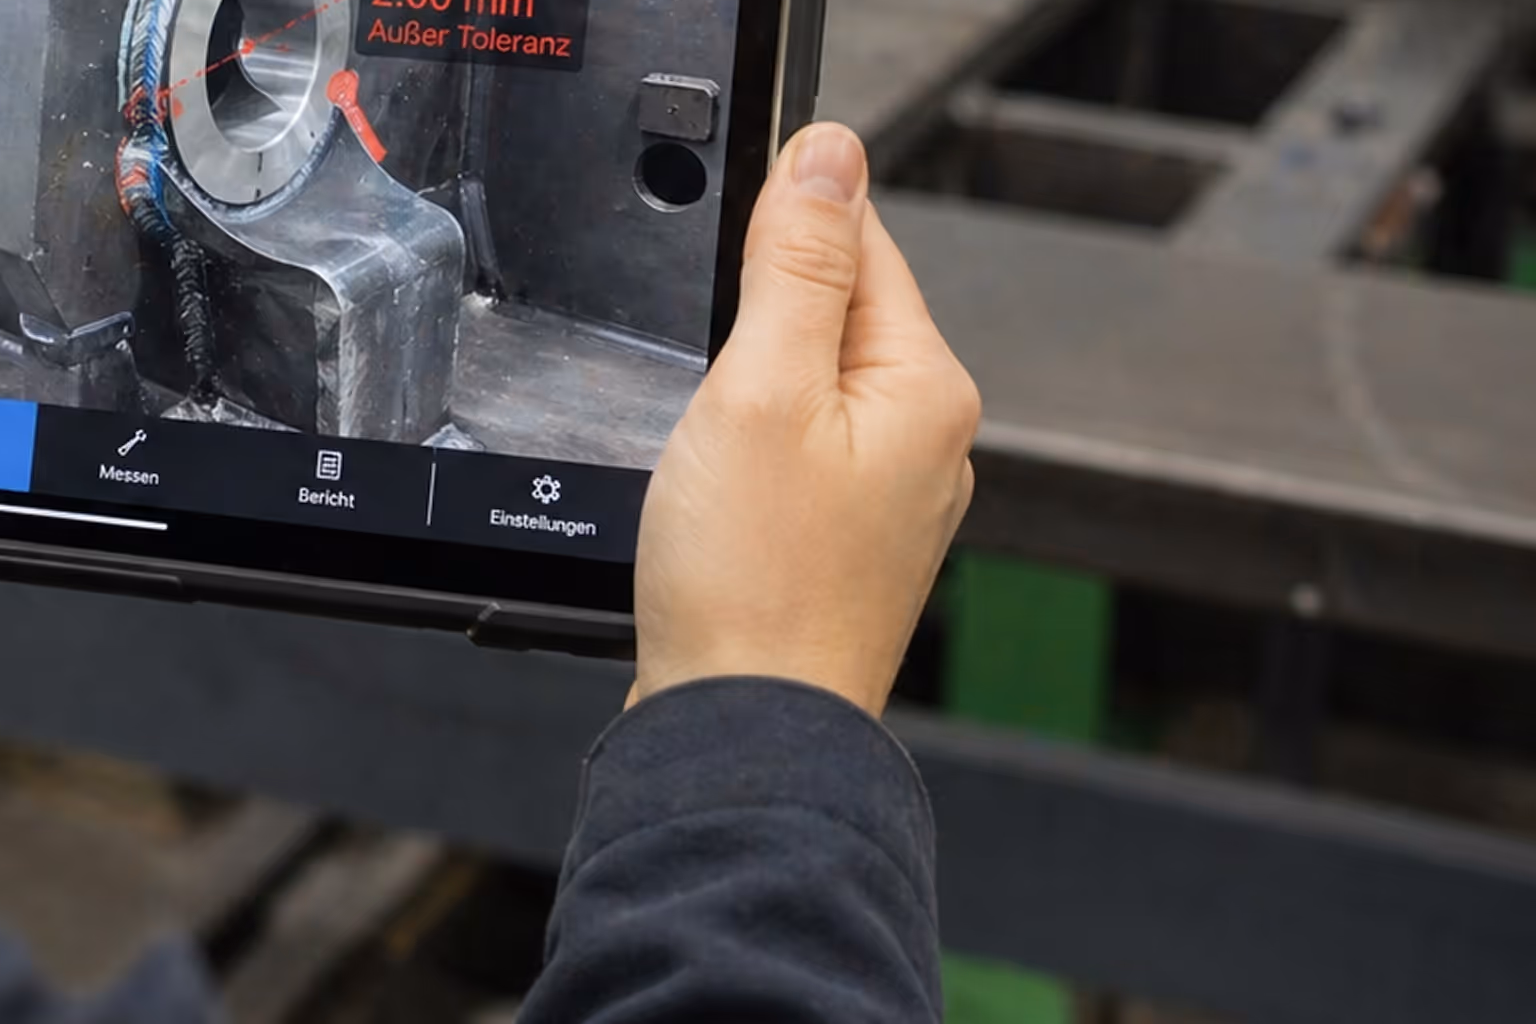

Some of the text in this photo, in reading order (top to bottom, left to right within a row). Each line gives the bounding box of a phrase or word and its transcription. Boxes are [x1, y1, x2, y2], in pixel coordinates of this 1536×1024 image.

[367, 19, 572, 58] Außer Toleranz
[98, 463, 160, 486] Messen
[298, 486, 356, 510] Bericht
[489, 508, 598, 538] Einstellungen
